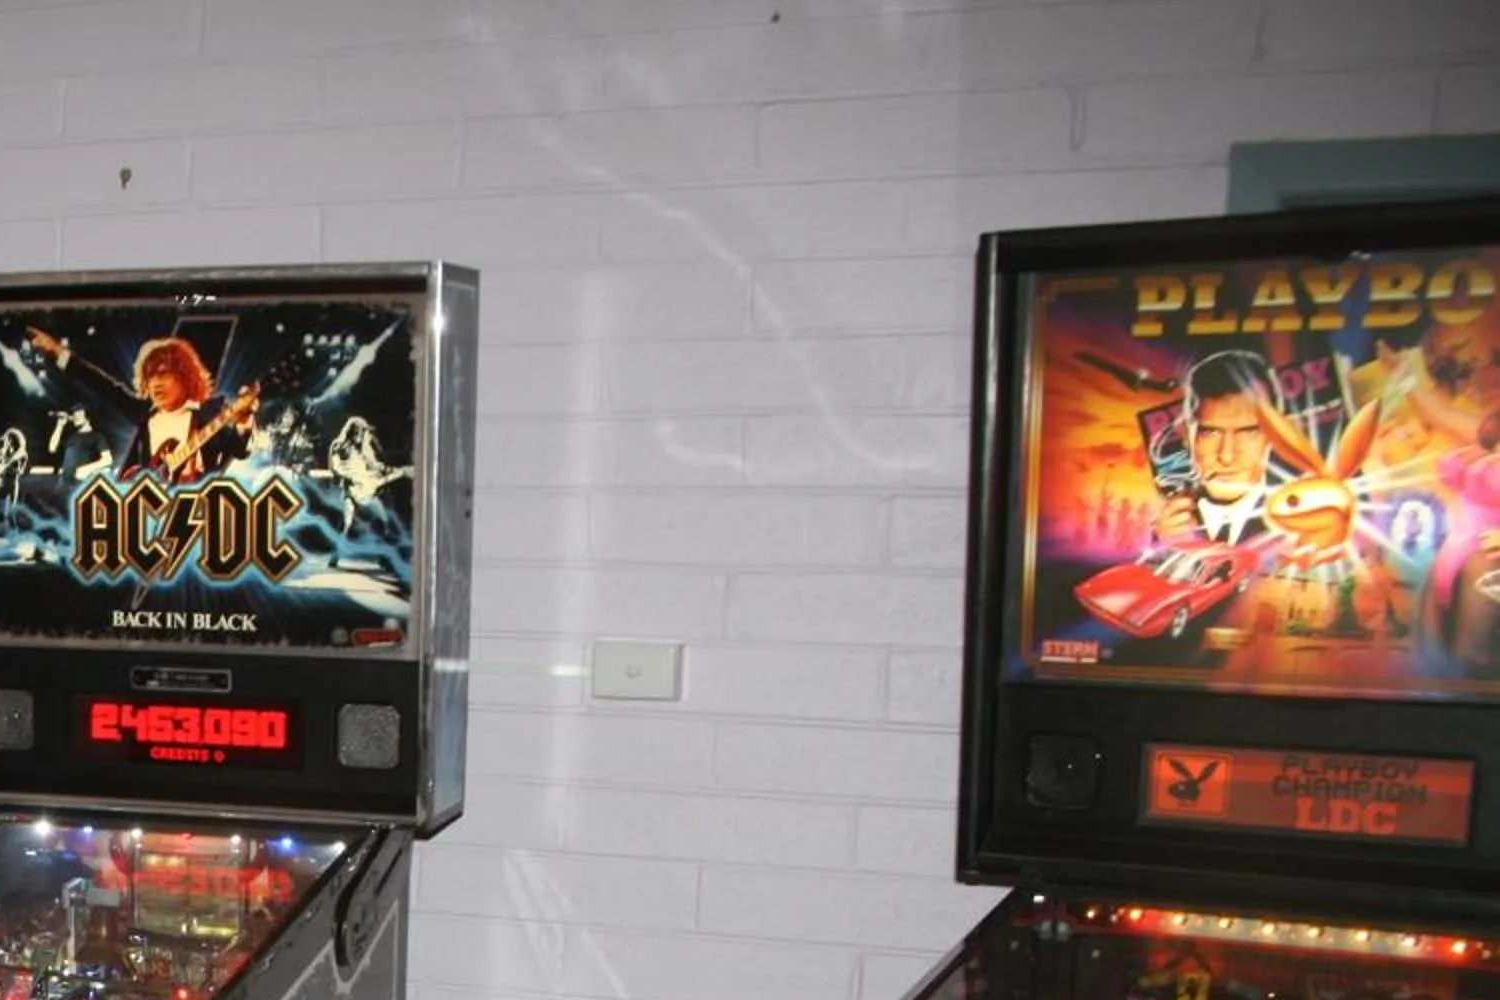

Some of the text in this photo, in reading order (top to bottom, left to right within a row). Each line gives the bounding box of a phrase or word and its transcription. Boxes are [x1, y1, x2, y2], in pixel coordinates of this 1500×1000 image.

[1131, 258, 1496, 337] PLAYBO
[72, 474, 303, 583] AC/DC
[112, 610, 257, 631] BACK IN BLACK
[150, 746, 209, 762] CREDITS
[1283, 754, 1419, 780] PLAYBOY
[1272, 775, 1428, 805] CHAMPION
[1295, 797, 1398, 835] LDC
